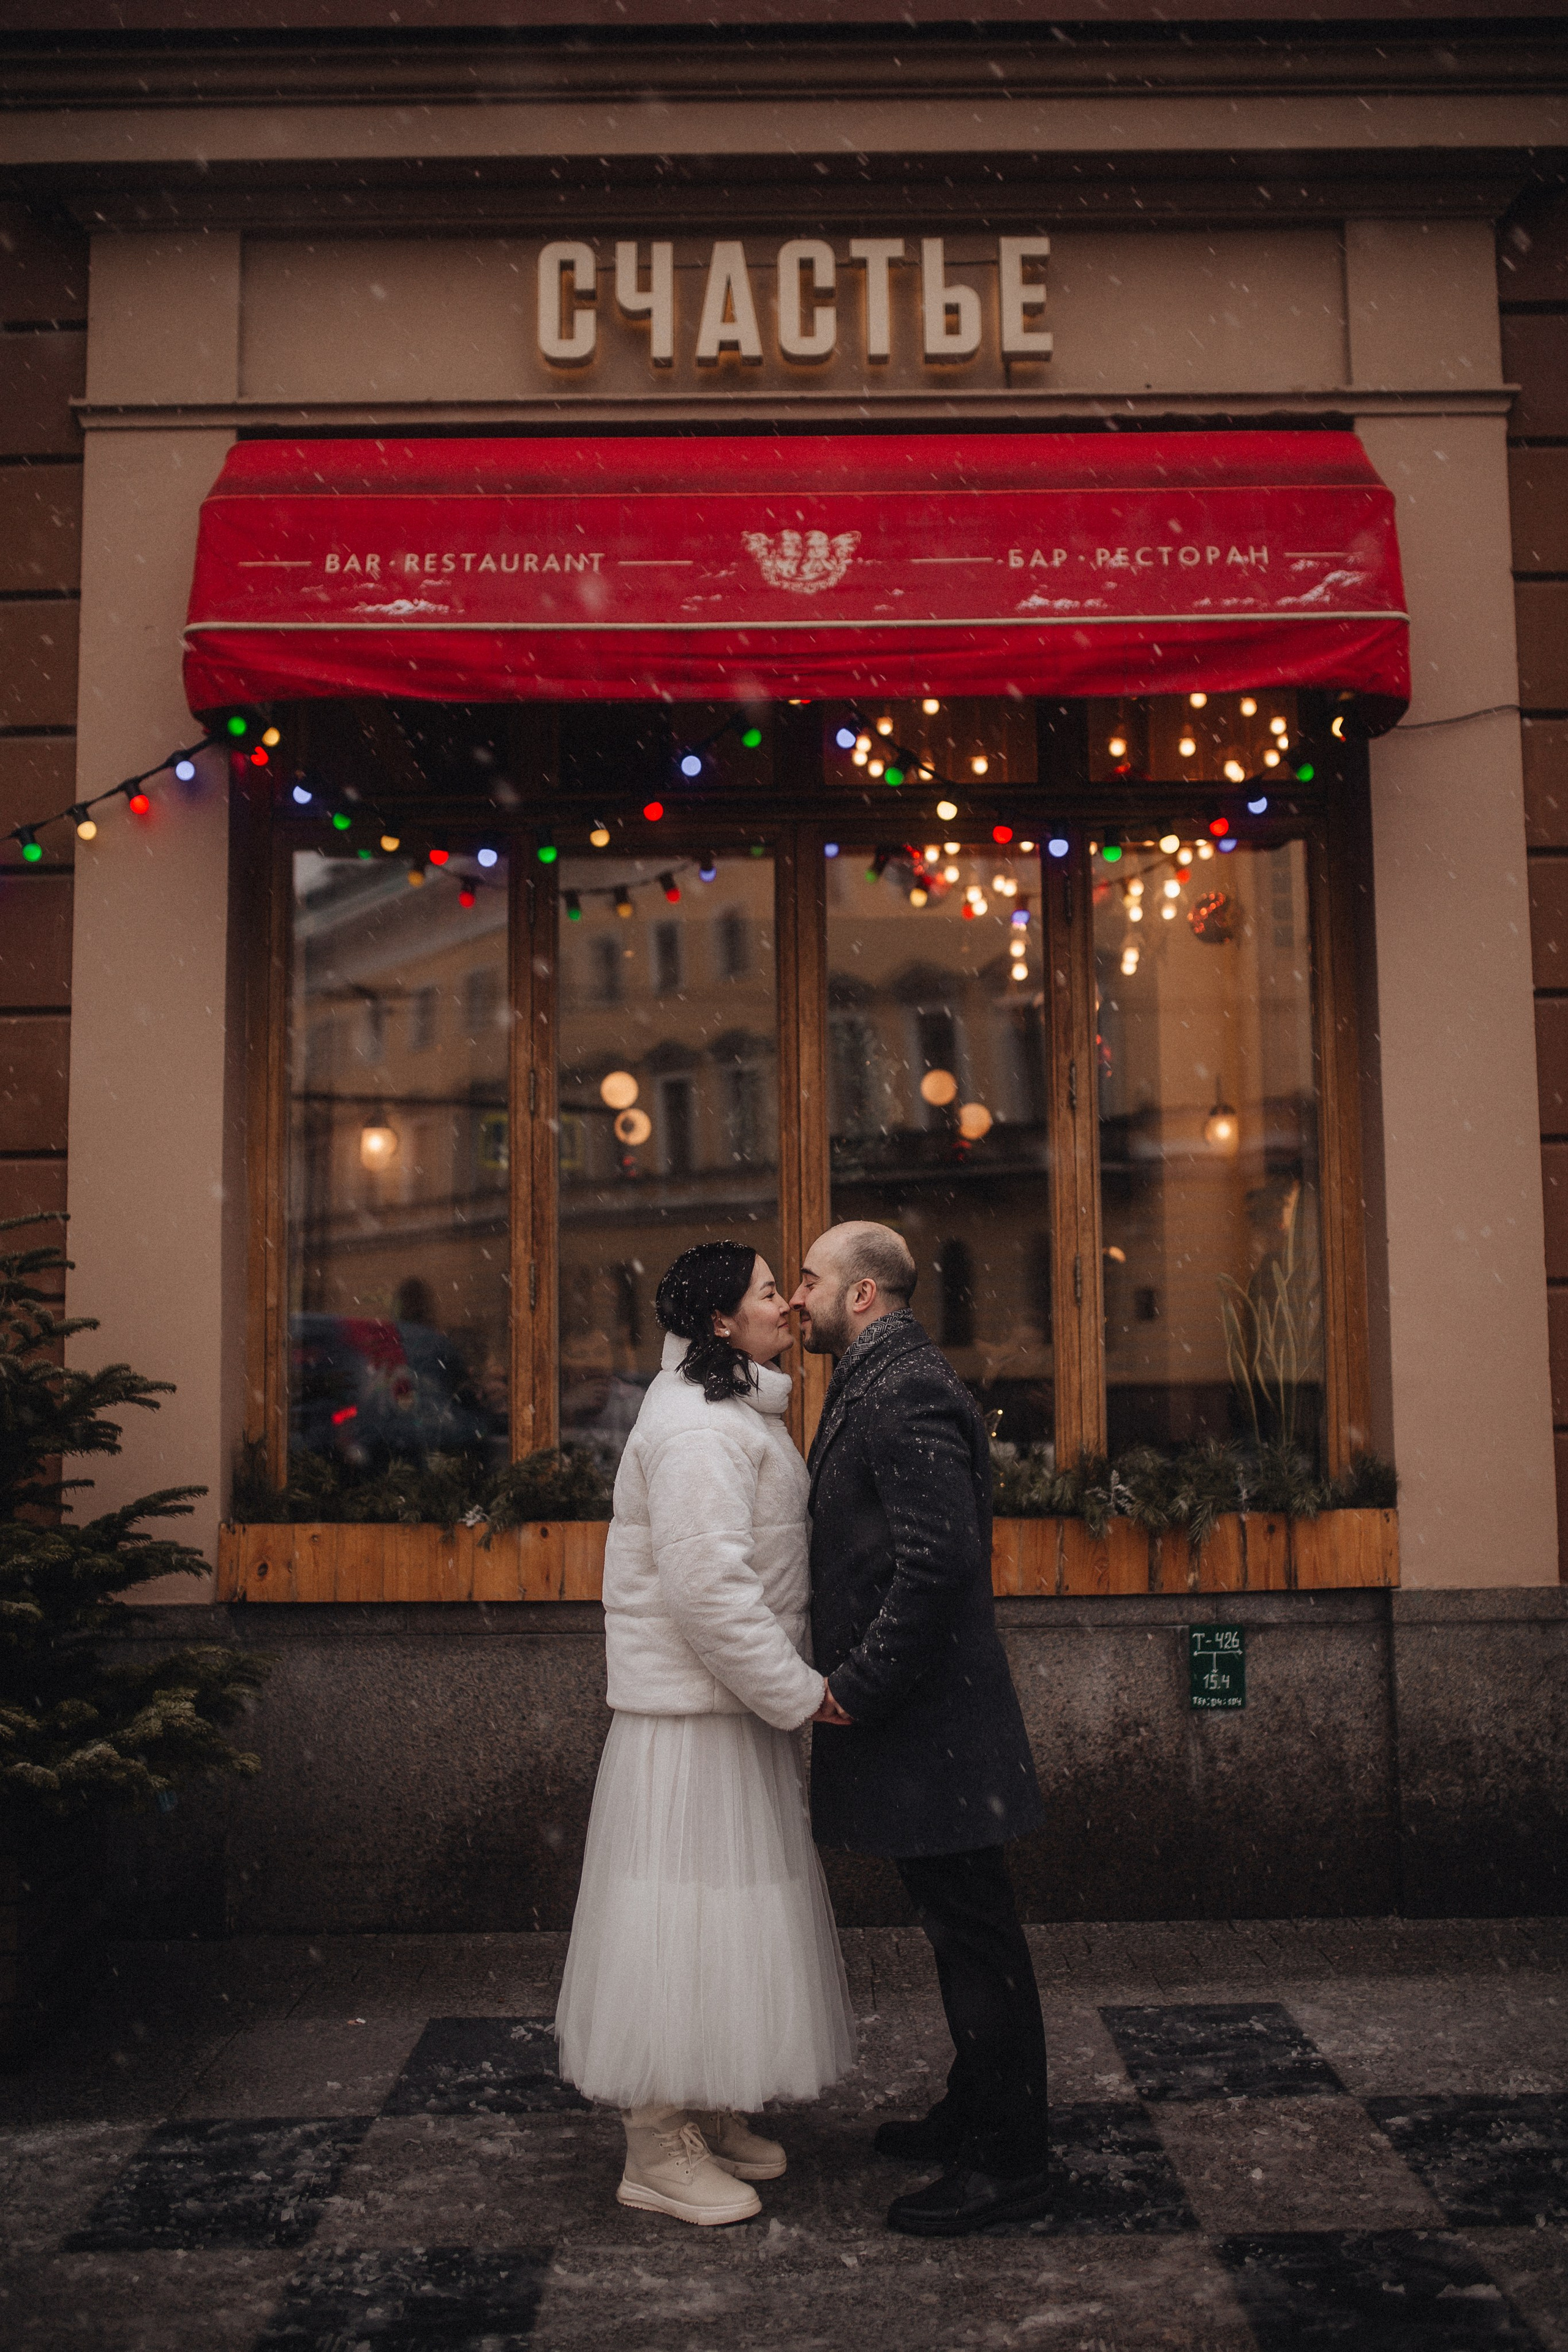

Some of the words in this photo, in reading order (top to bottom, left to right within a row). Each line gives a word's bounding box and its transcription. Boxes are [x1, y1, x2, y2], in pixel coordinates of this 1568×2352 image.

[537, 236, 1054, 368] СЧАСТЬЕ
[324, 552, 380, 574] BAR
[404, 552, 605, 574] RESTAURANT
[1008, 549, 1068, 568] БАР
[1095, 545, 1269, 568] РЕСТОРАН
